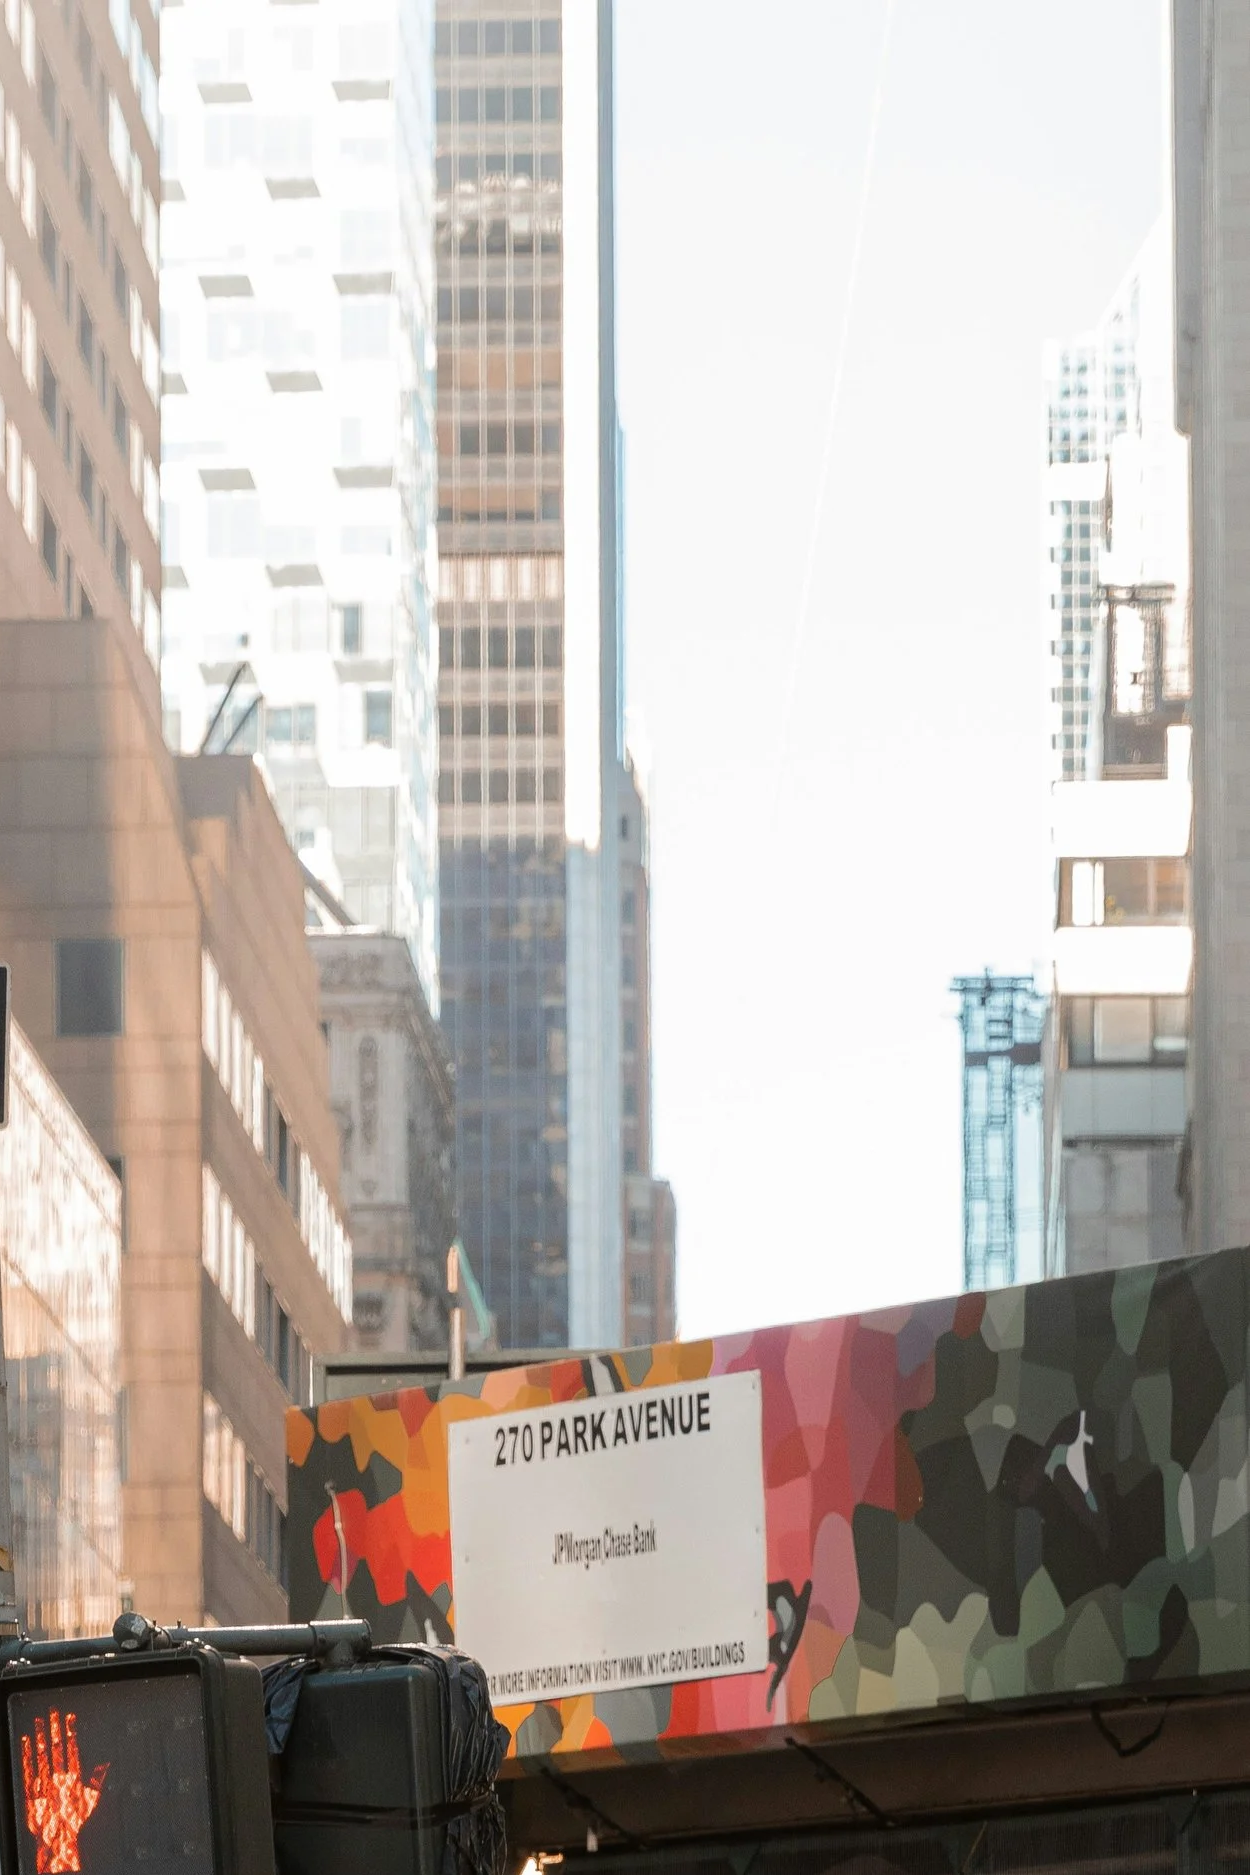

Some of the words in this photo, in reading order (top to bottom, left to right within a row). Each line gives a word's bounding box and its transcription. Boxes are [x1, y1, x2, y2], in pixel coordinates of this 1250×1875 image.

[495, 1423, 534, 1468] 270
[539, 1410, 607, 1460] PARK
[612, 1391, 711, 1447] AVENUE
[603, 1526, 631, 1558] Chase
[633, 1519, 657, 1554] Bank
[501, 1672, 524, 1695] MORE
[526, 1663, 592, 1690] INFORMATION
[593, 1659, 618, 1681] VISIT
